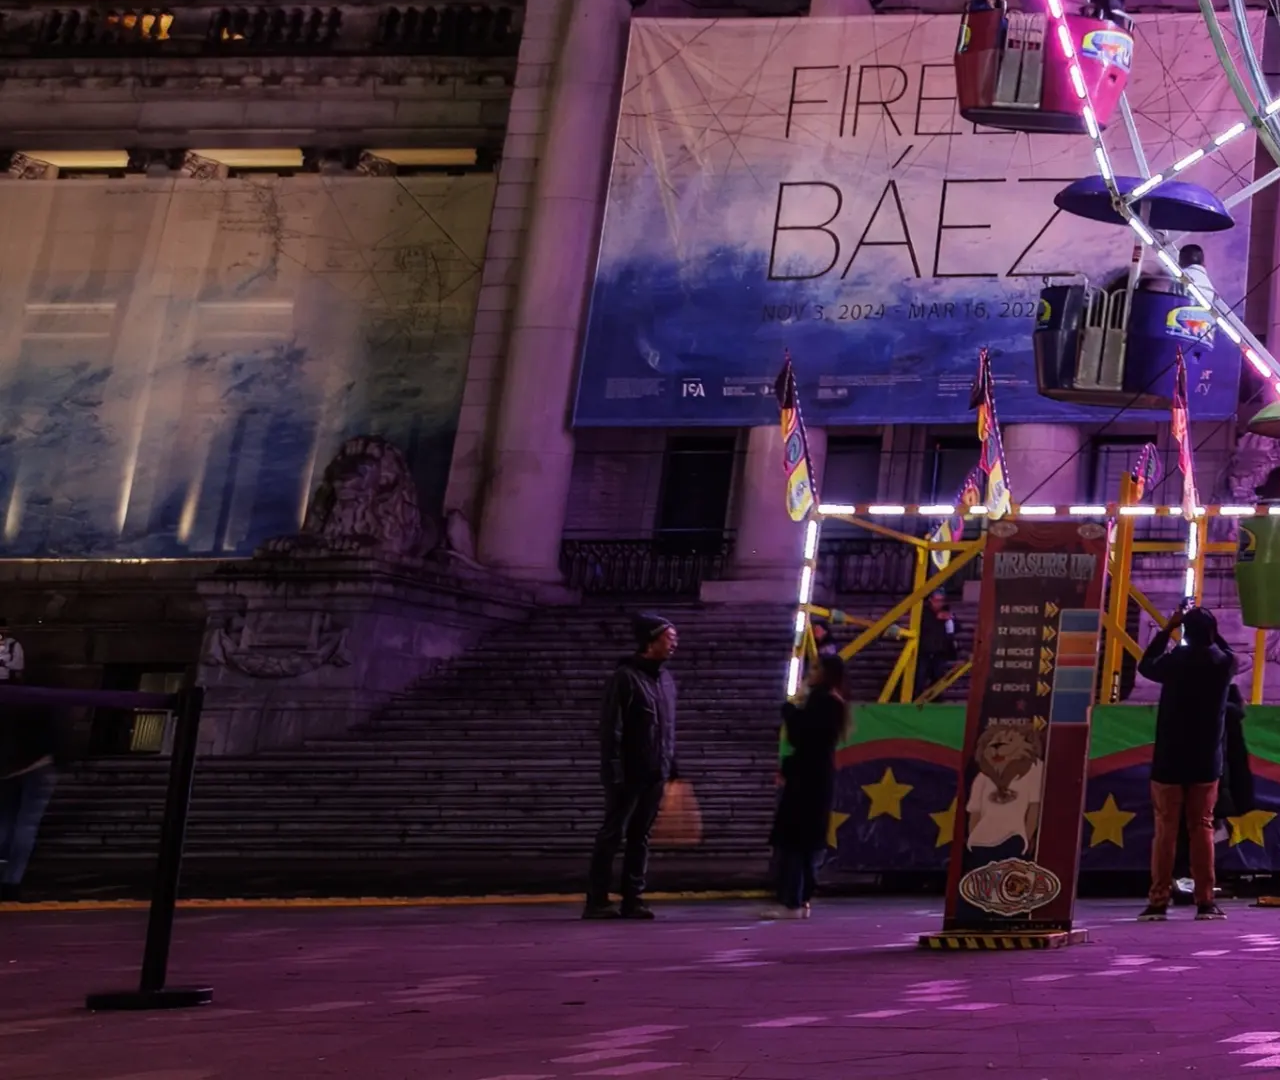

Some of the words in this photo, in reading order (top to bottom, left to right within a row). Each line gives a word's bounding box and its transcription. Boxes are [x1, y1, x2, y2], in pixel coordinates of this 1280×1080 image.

[767, 144, 1084, 281] BÁEZ
[762, 305, 806, 320] NOV
[838, 303, 886, 320] 2024
[908, 302, 956, 319] MAR
[999, 301, 1036, 319] 202
